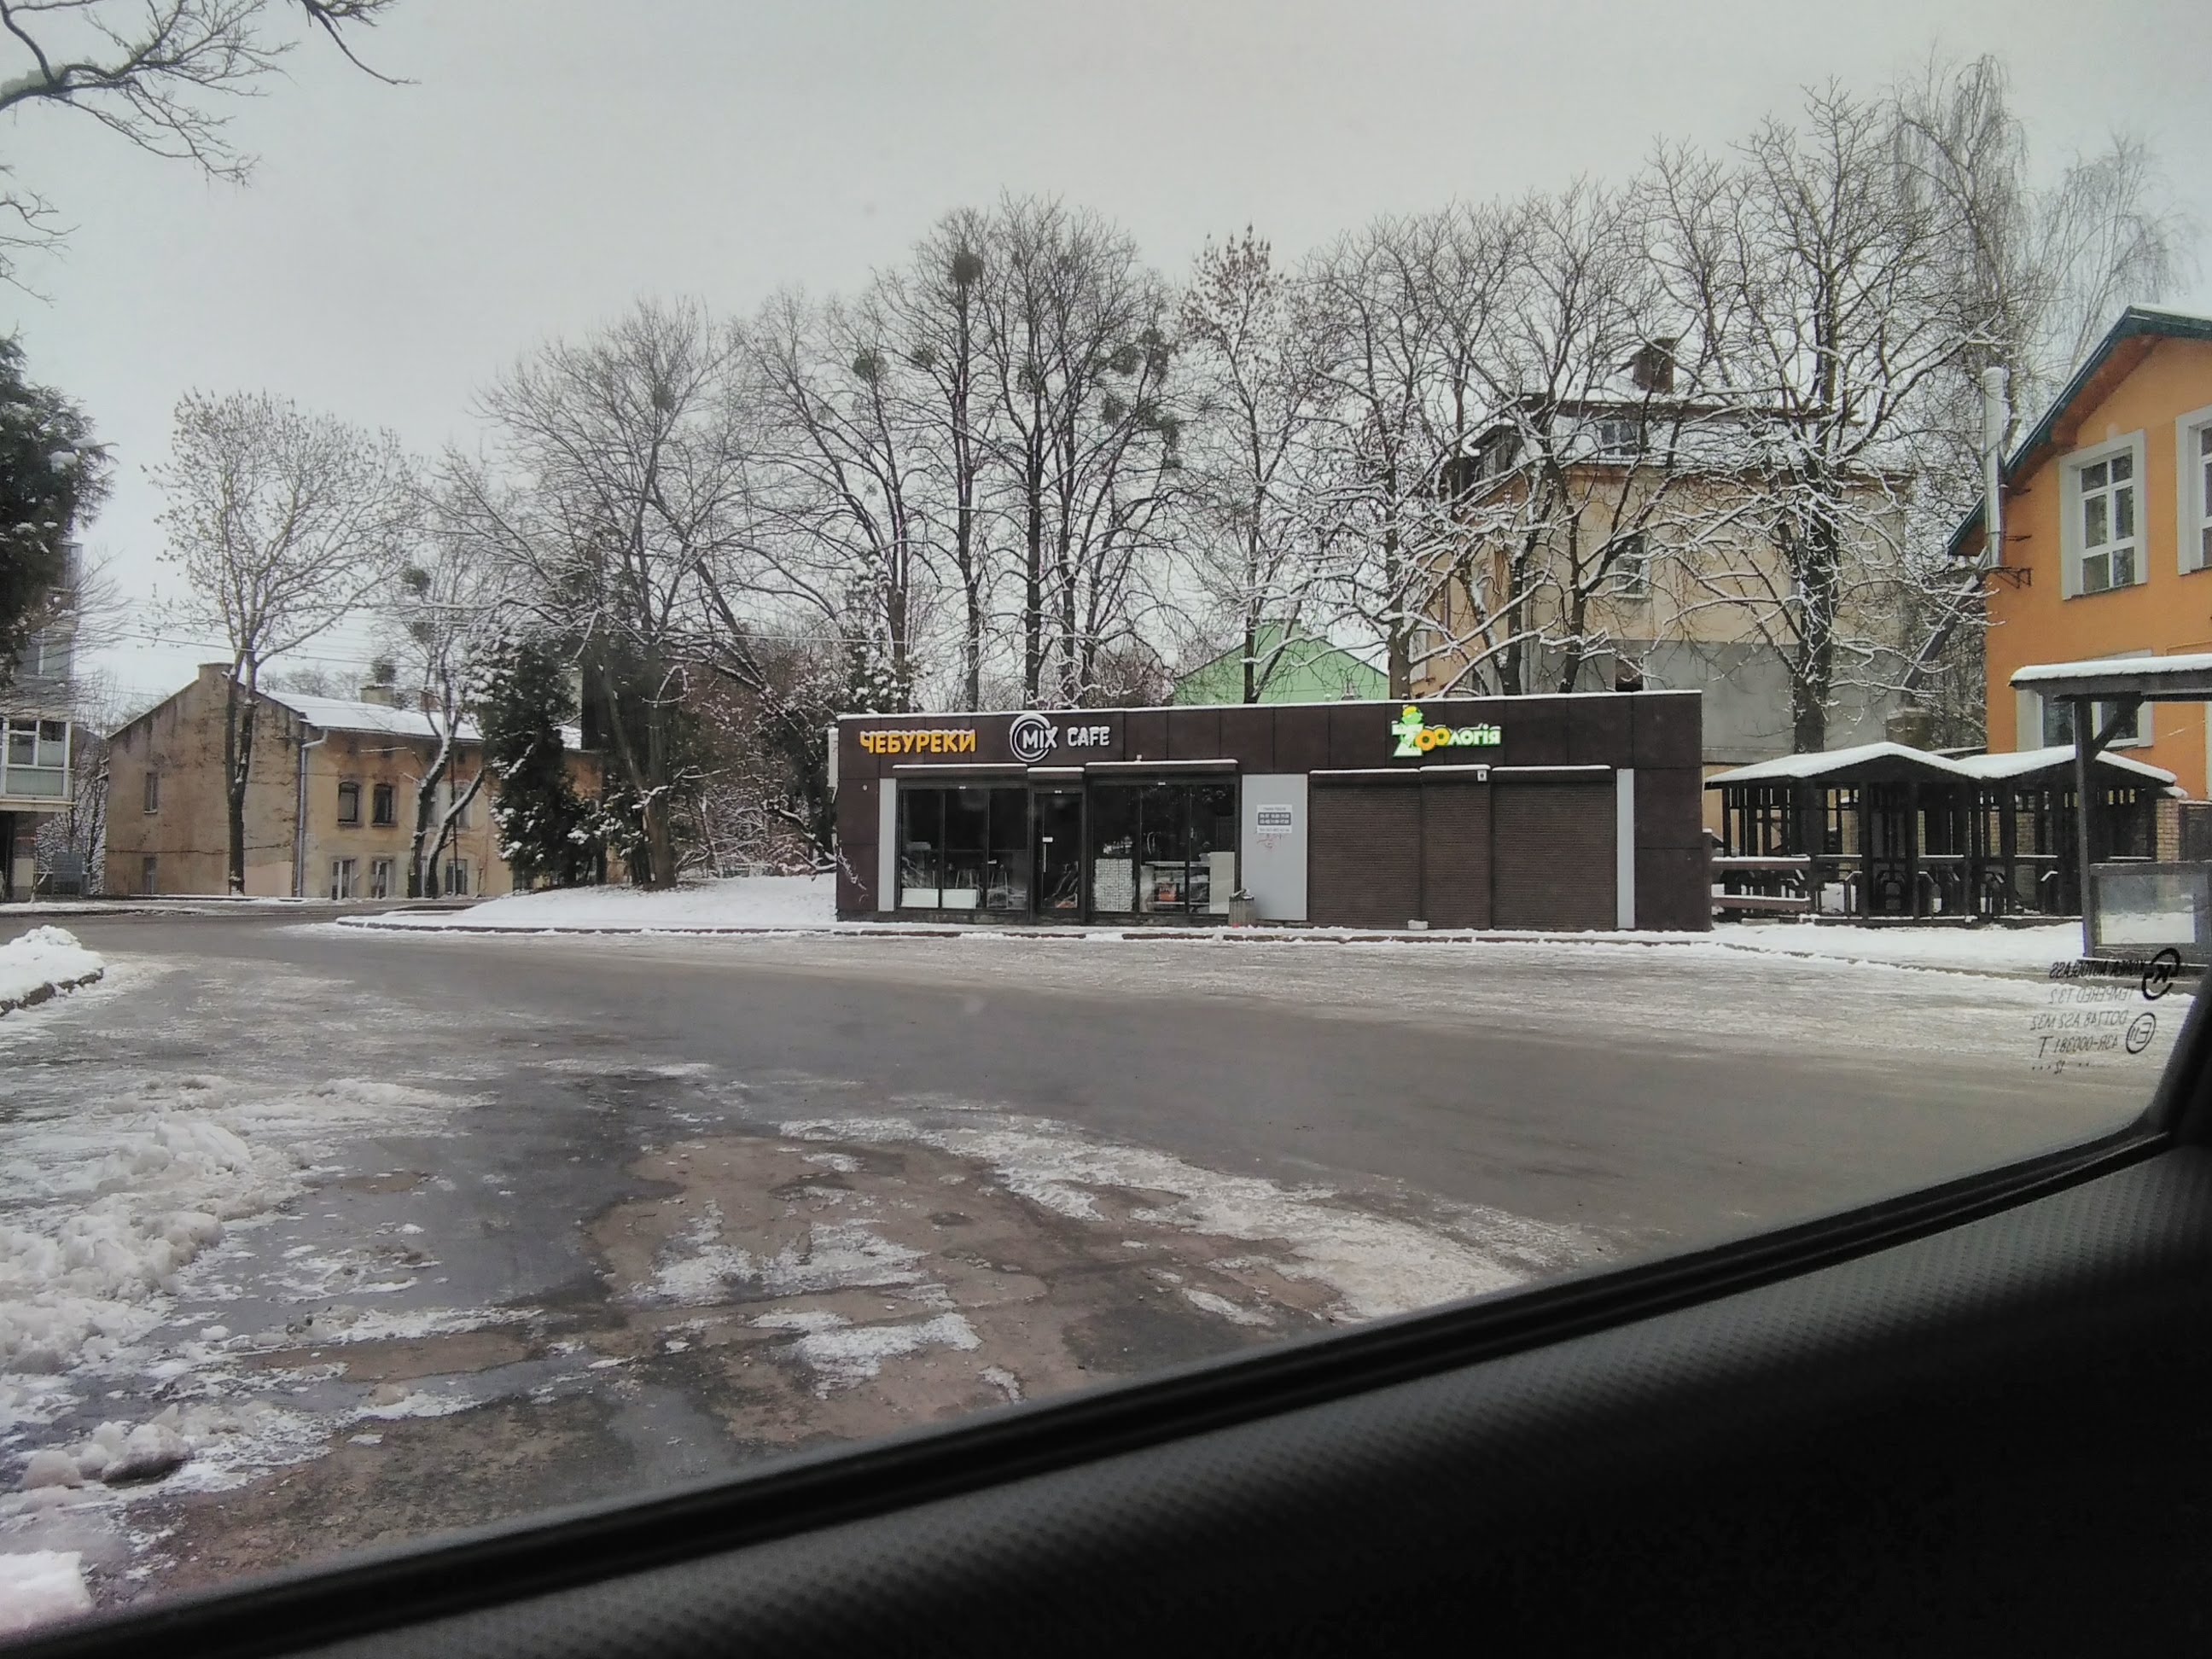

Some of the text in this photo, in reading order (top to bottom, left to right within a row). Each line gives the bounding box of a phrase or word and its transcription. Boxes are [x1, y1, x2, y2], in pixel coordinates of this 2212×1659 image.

[860, 730, 976, 754] ЧЕБУРЕКИ
[1023, 725, 1110, 748] MIX CAFE
